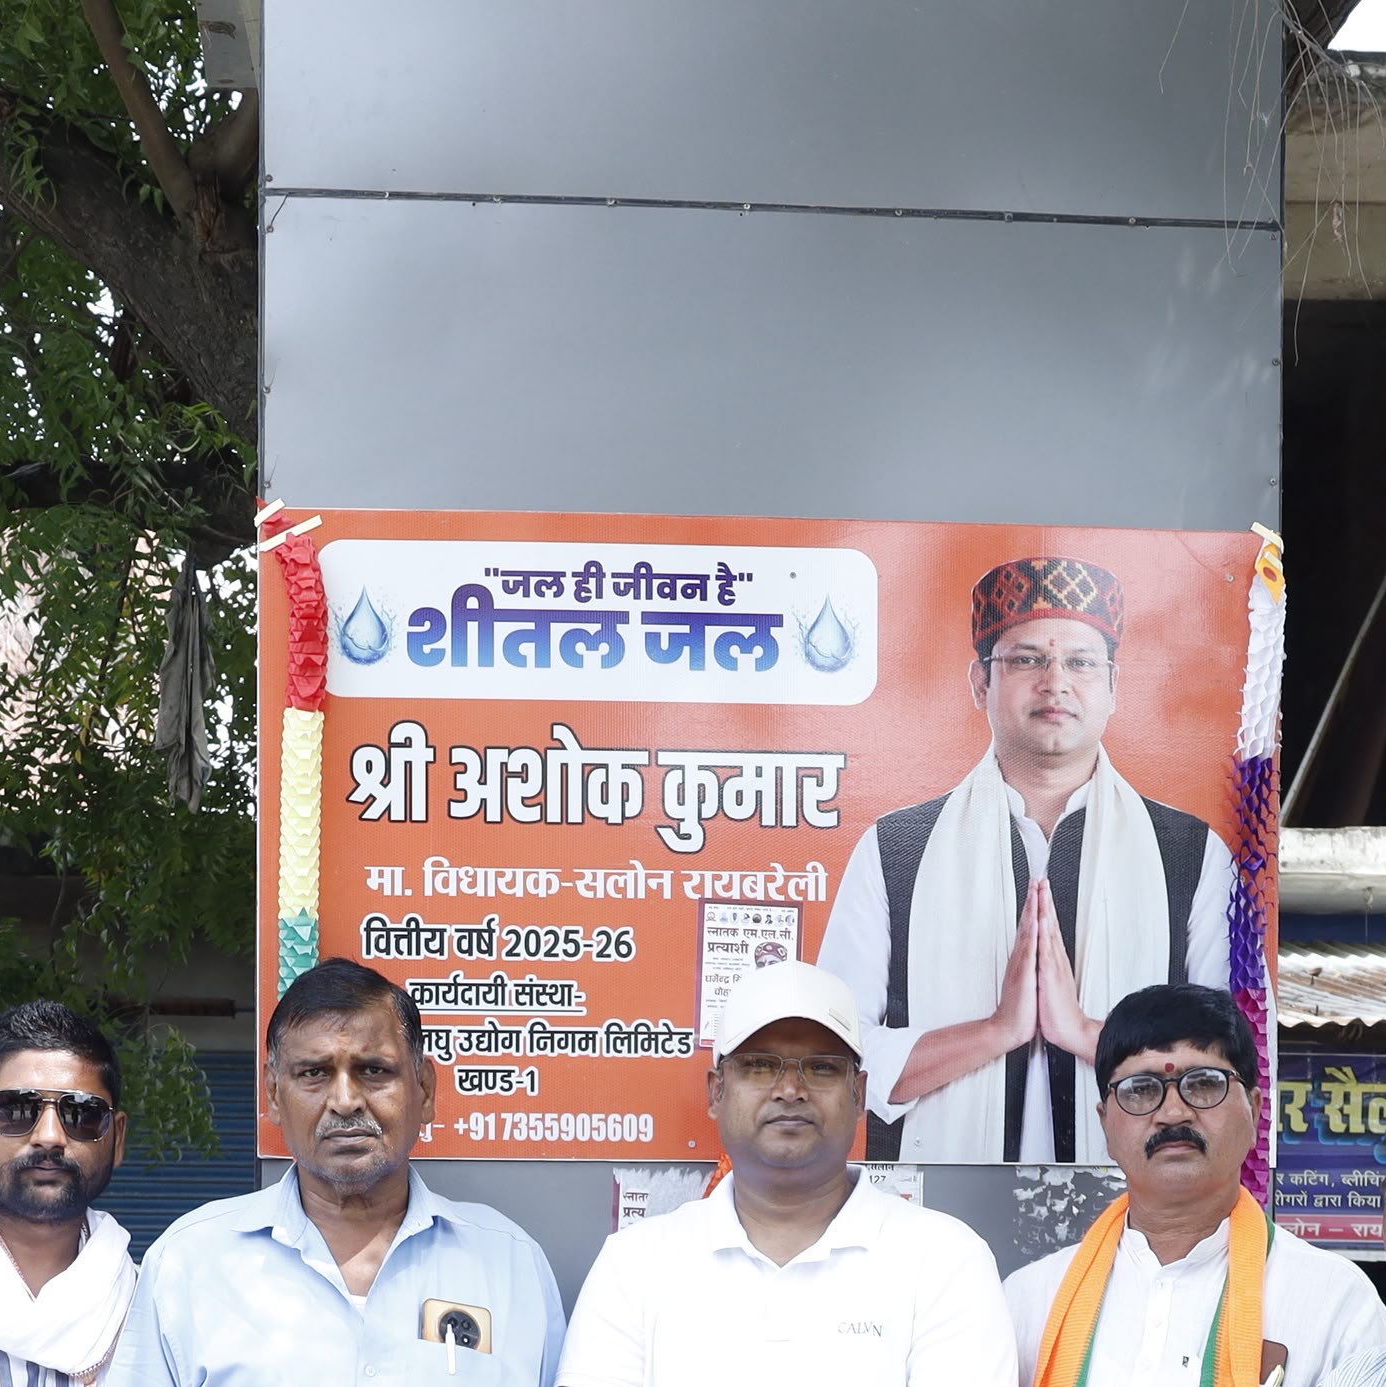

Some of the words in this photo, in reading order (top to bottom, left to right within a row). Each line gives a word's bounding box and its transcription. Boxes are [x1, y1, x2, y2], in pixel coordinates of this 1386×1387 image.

[573, 560, 607, 603] ही
[612, 561, 708, 602] जीवन
[407, 583, 629, 669] शीतल
[641, 612, 784, 672] जल
[346, 720, 436, 824] श्री
[448, 723, 650, 825] अशोक
[654, 747, 848, 854] कुमार
[364, 865, 413, 898] मा.
[682, 861, 828, 902] रायबरेली
[363, 916, 447, 957] वित्तीय
[455, 916, 496, 958] वर्ष
[505, 929, 634, 959] 2025-26
[707, 940, 749, 954] प्रत्याशी
[409, 974, 507, 1006] कार्यदायी
[514, 978, 583, 1007] संस्था-
[458, 1020, 522, 1053] उद्योग
[528, 1021, 598, 1054] निगम
[604, 1022, 693, 1055] लिमिटेड
[457, 1068, 536, 1093] खण्ड-1
[1313, 1194, 1342, 1208] द्वारा
[1347, 1191, 1382, 1208] किया
